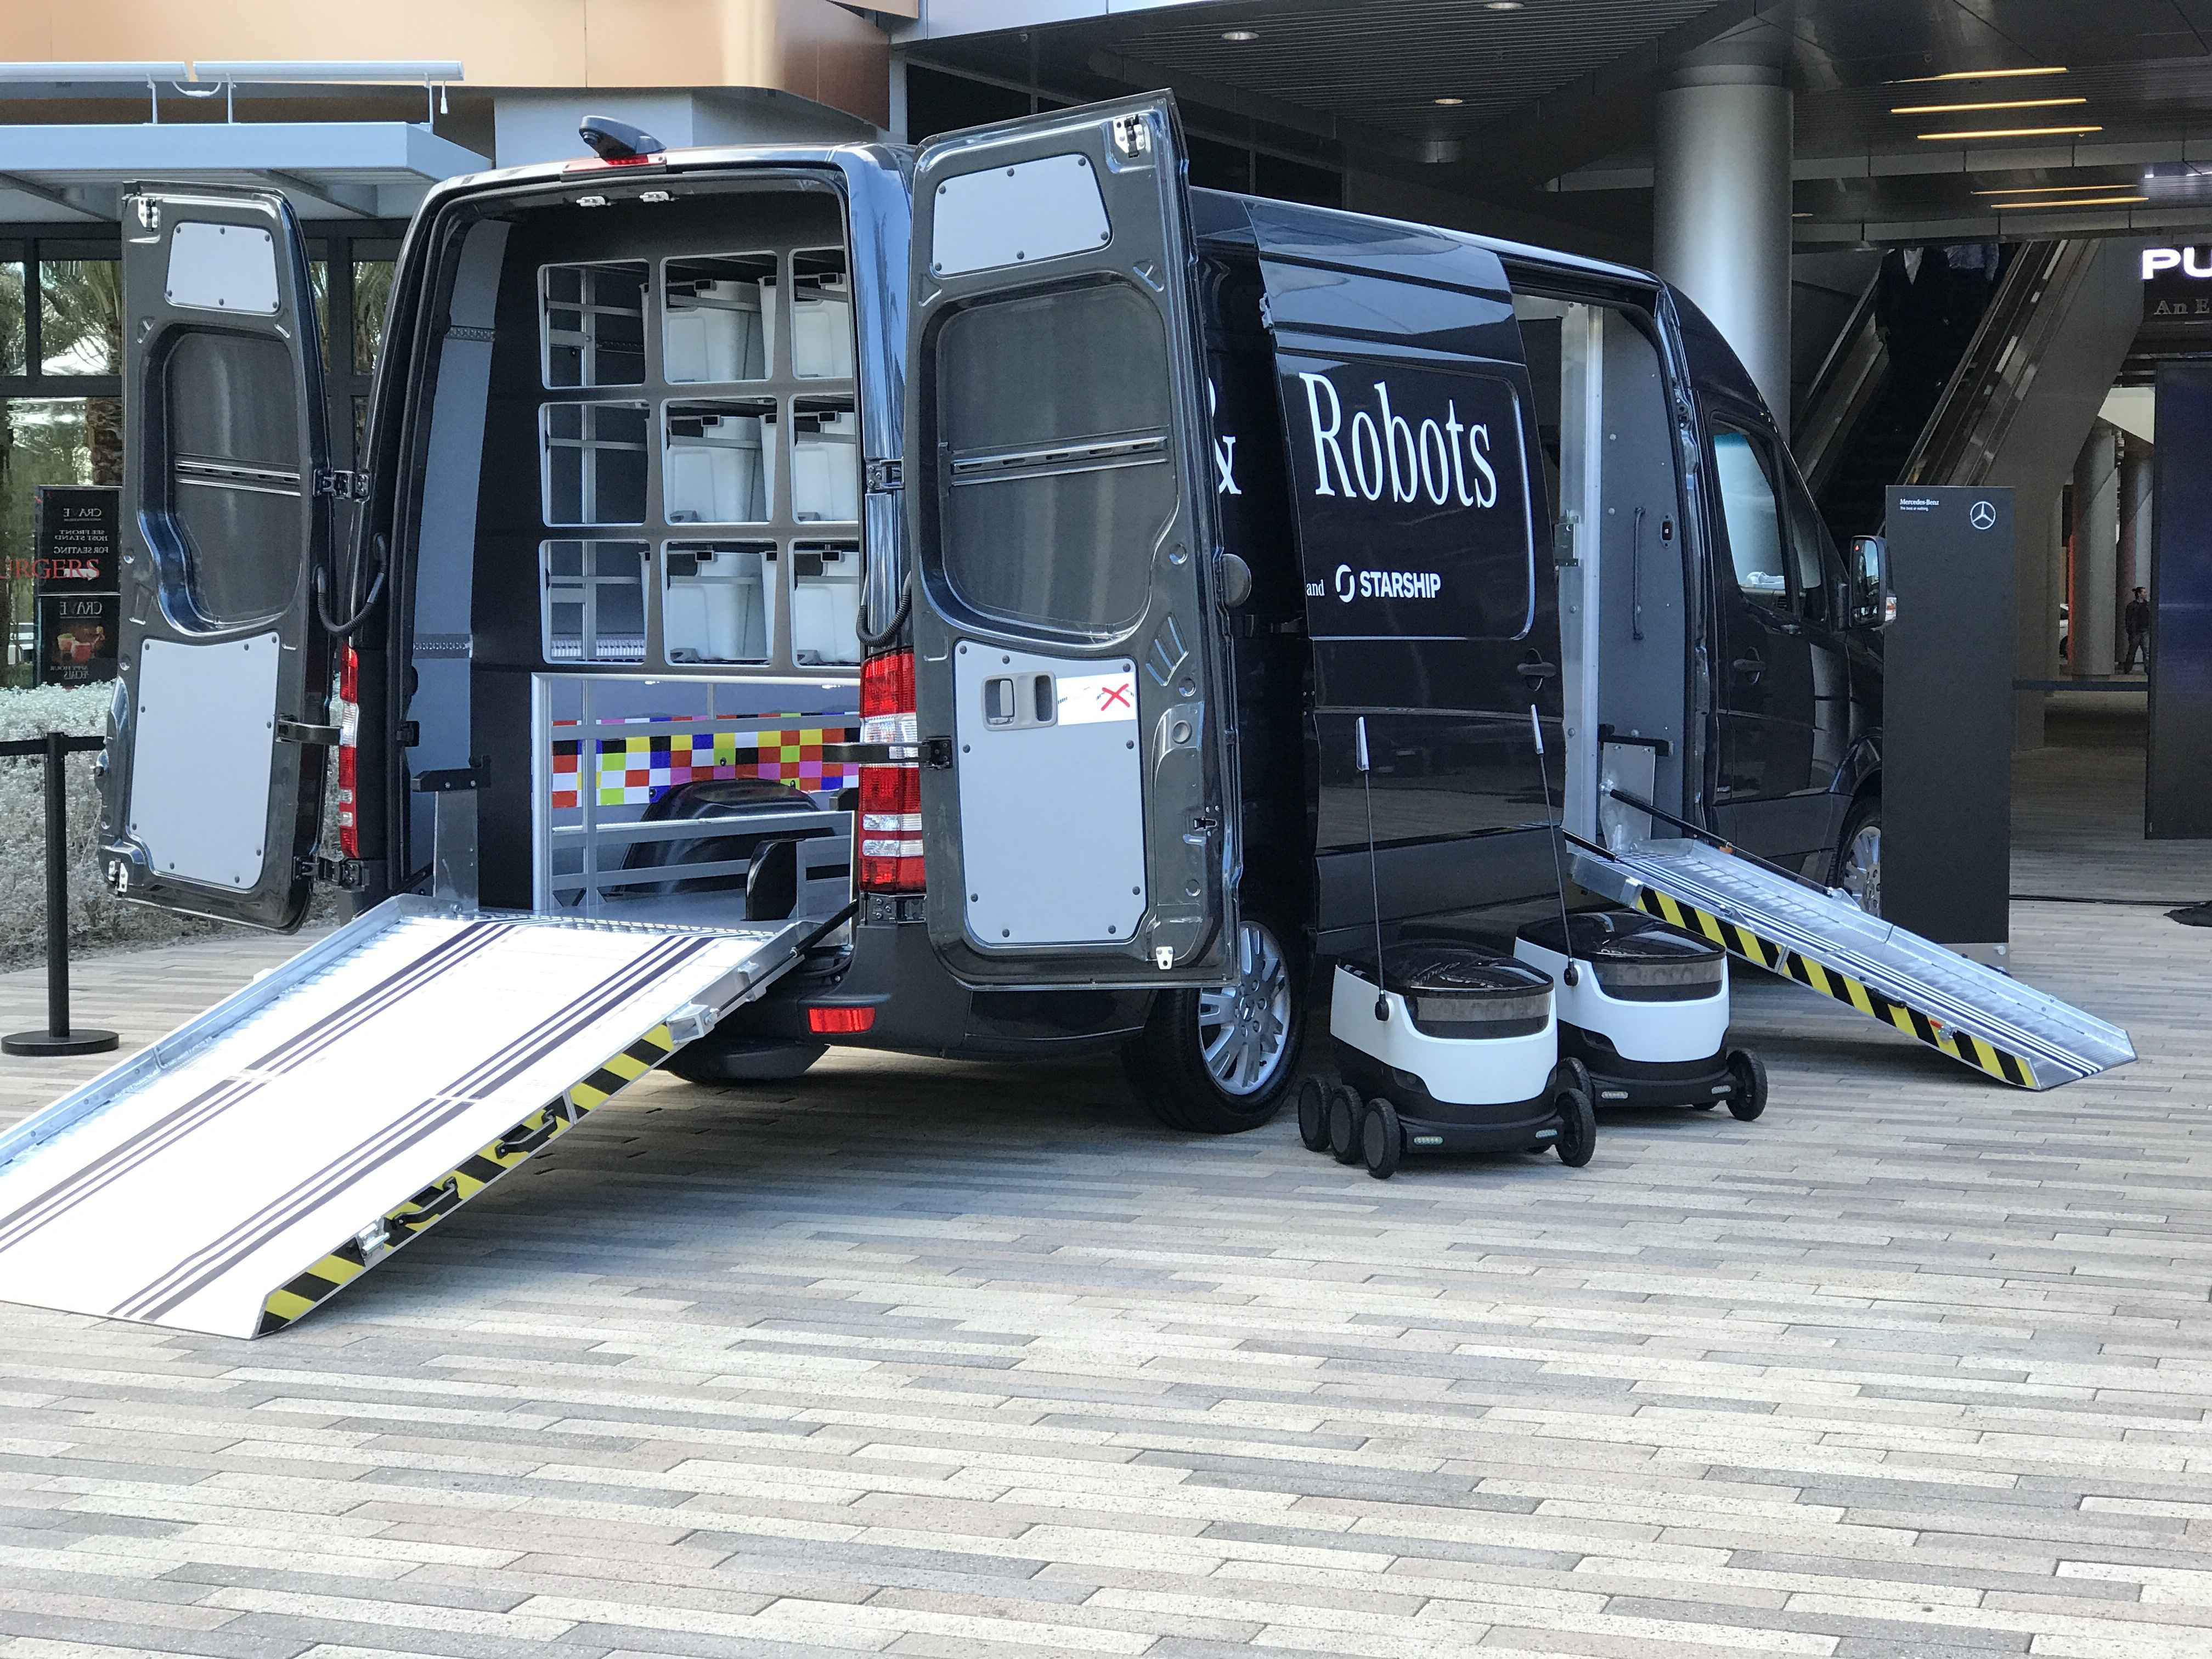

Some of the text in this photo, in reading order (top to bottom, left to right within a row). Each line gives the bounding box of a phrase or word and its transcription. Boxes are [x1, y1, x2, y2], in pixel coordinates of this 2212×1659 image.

[2142, 246, 2212, 279] PU
[2153, 300, 2188, 314] An
[1299, 371, 1497, 508] Robots
[1306, 571, 1441, 599] and STARSHIP
